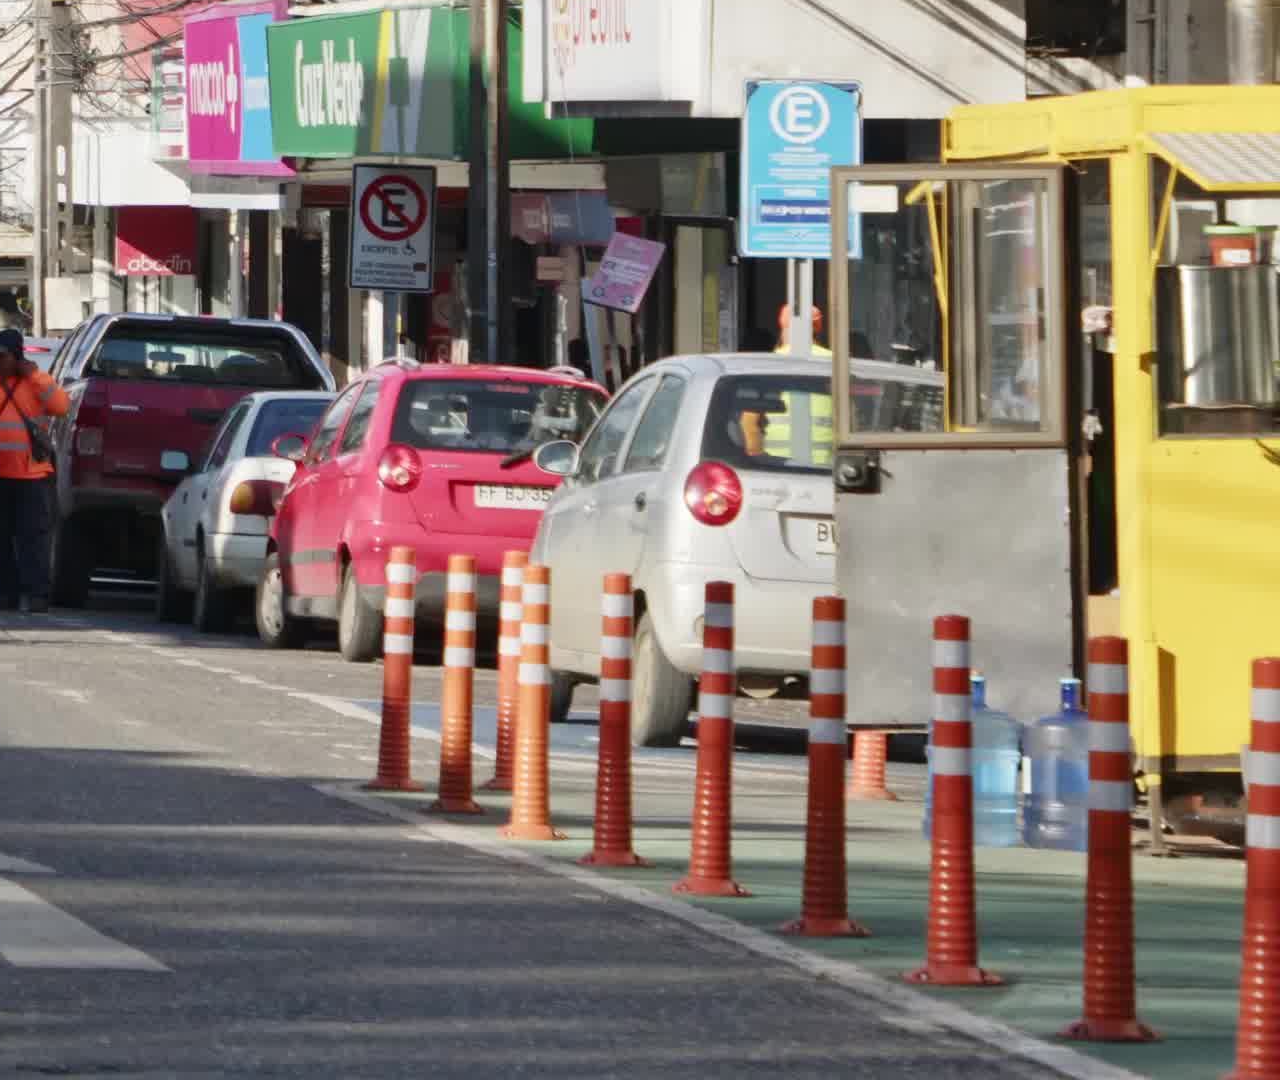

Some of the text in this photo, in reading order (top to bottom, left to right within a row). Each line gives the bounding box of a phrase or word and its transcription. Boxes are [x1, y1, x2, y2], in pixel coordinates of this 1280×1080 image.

[296, 39, 326, 128] Cruz
[322, 37, 364, 127] Verde
[786, 97, 816, 133] E
[128, 252, 192, 272] abcdin
